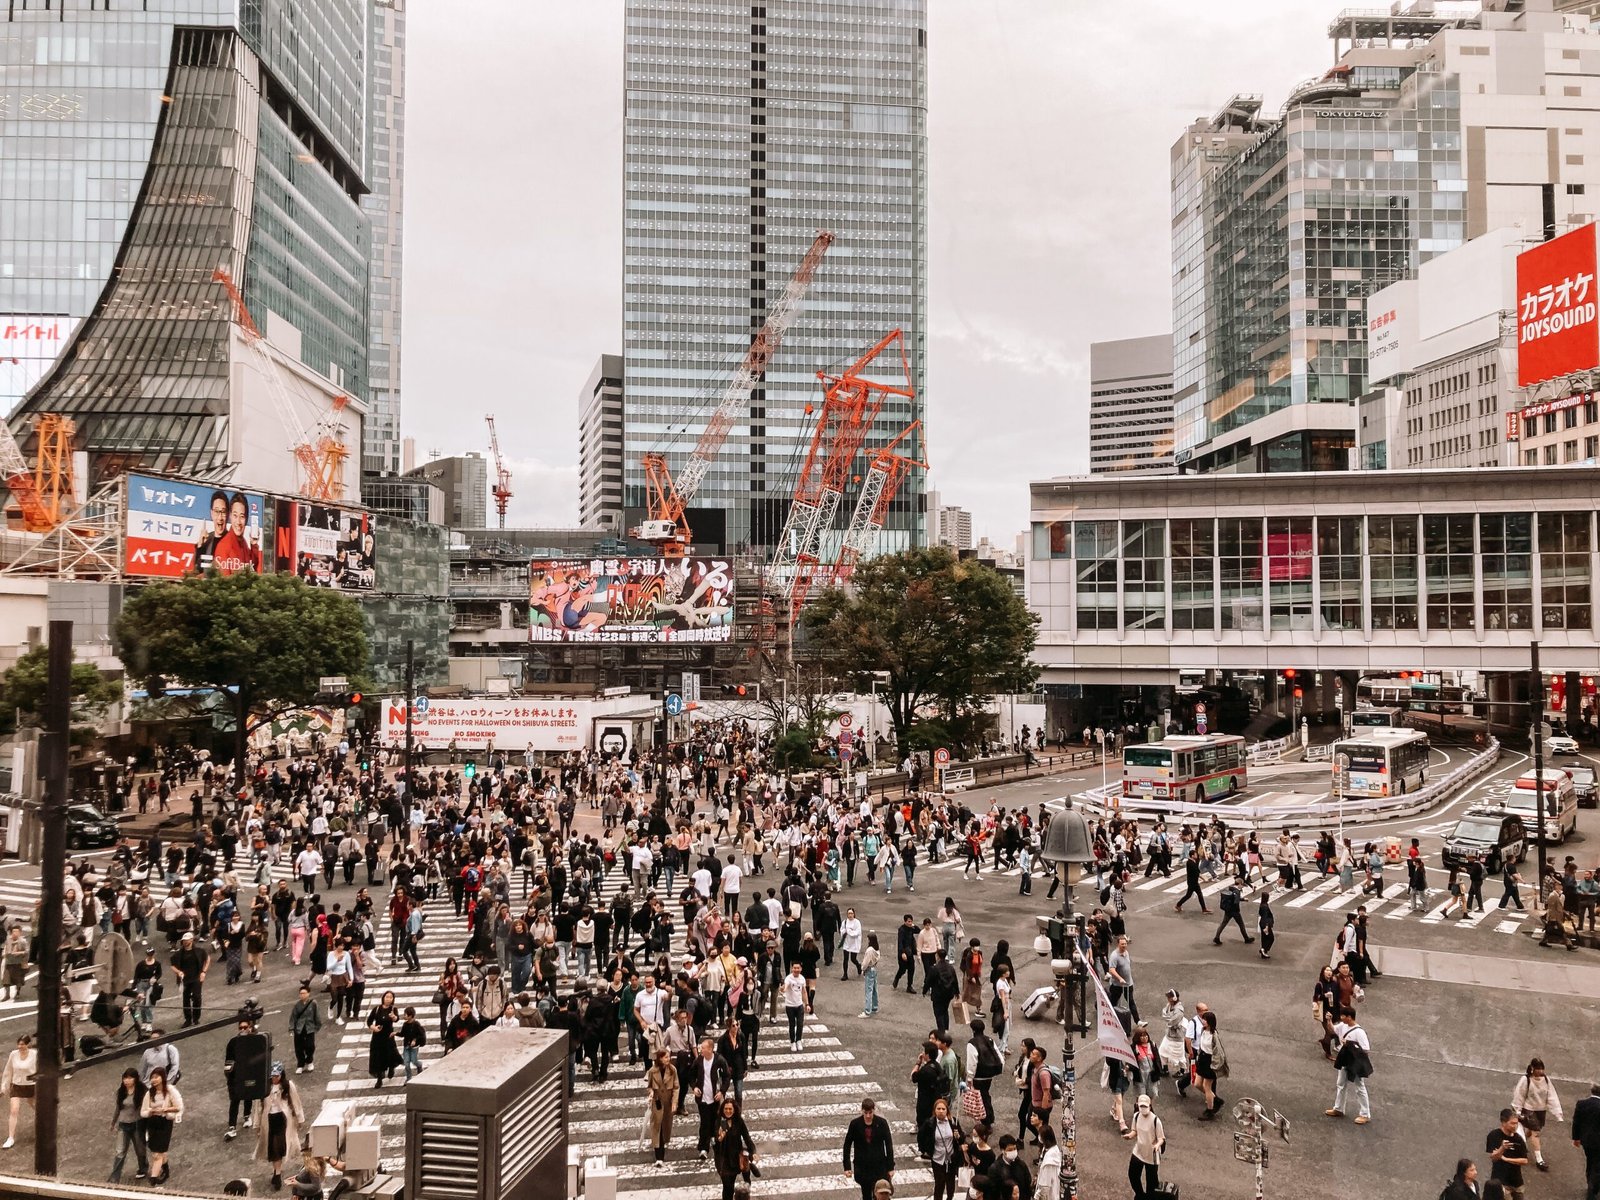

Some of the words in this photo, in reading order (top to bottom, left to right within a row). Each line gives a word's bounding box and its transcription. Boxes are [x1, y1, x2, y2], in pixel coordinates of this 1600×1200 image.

[1316, 110, 1350, 118] TOKYU
[1521, 272, 1594, 322] カラオケ
[1521, 302, 1596, 345] JOYSOUND
[1525, 404, 1549, 417] カラオケ
[156, 490, 197, 508] オトク
[141, 519, 195, 537] オドロク
[130, 547, 194, 567] ペイトク
[214, 555, 255, 572] SoftBank
[438, 719, 460, 727] EVENTS
[461, 719, 473, 727] FOR
[474, 719, 511, 727] HALLOWEEN
[511, 719, 521, 727] ON
[522, 720, 549, 728] SHIBUYA
[466, 730, 497, 738] SMOKING
